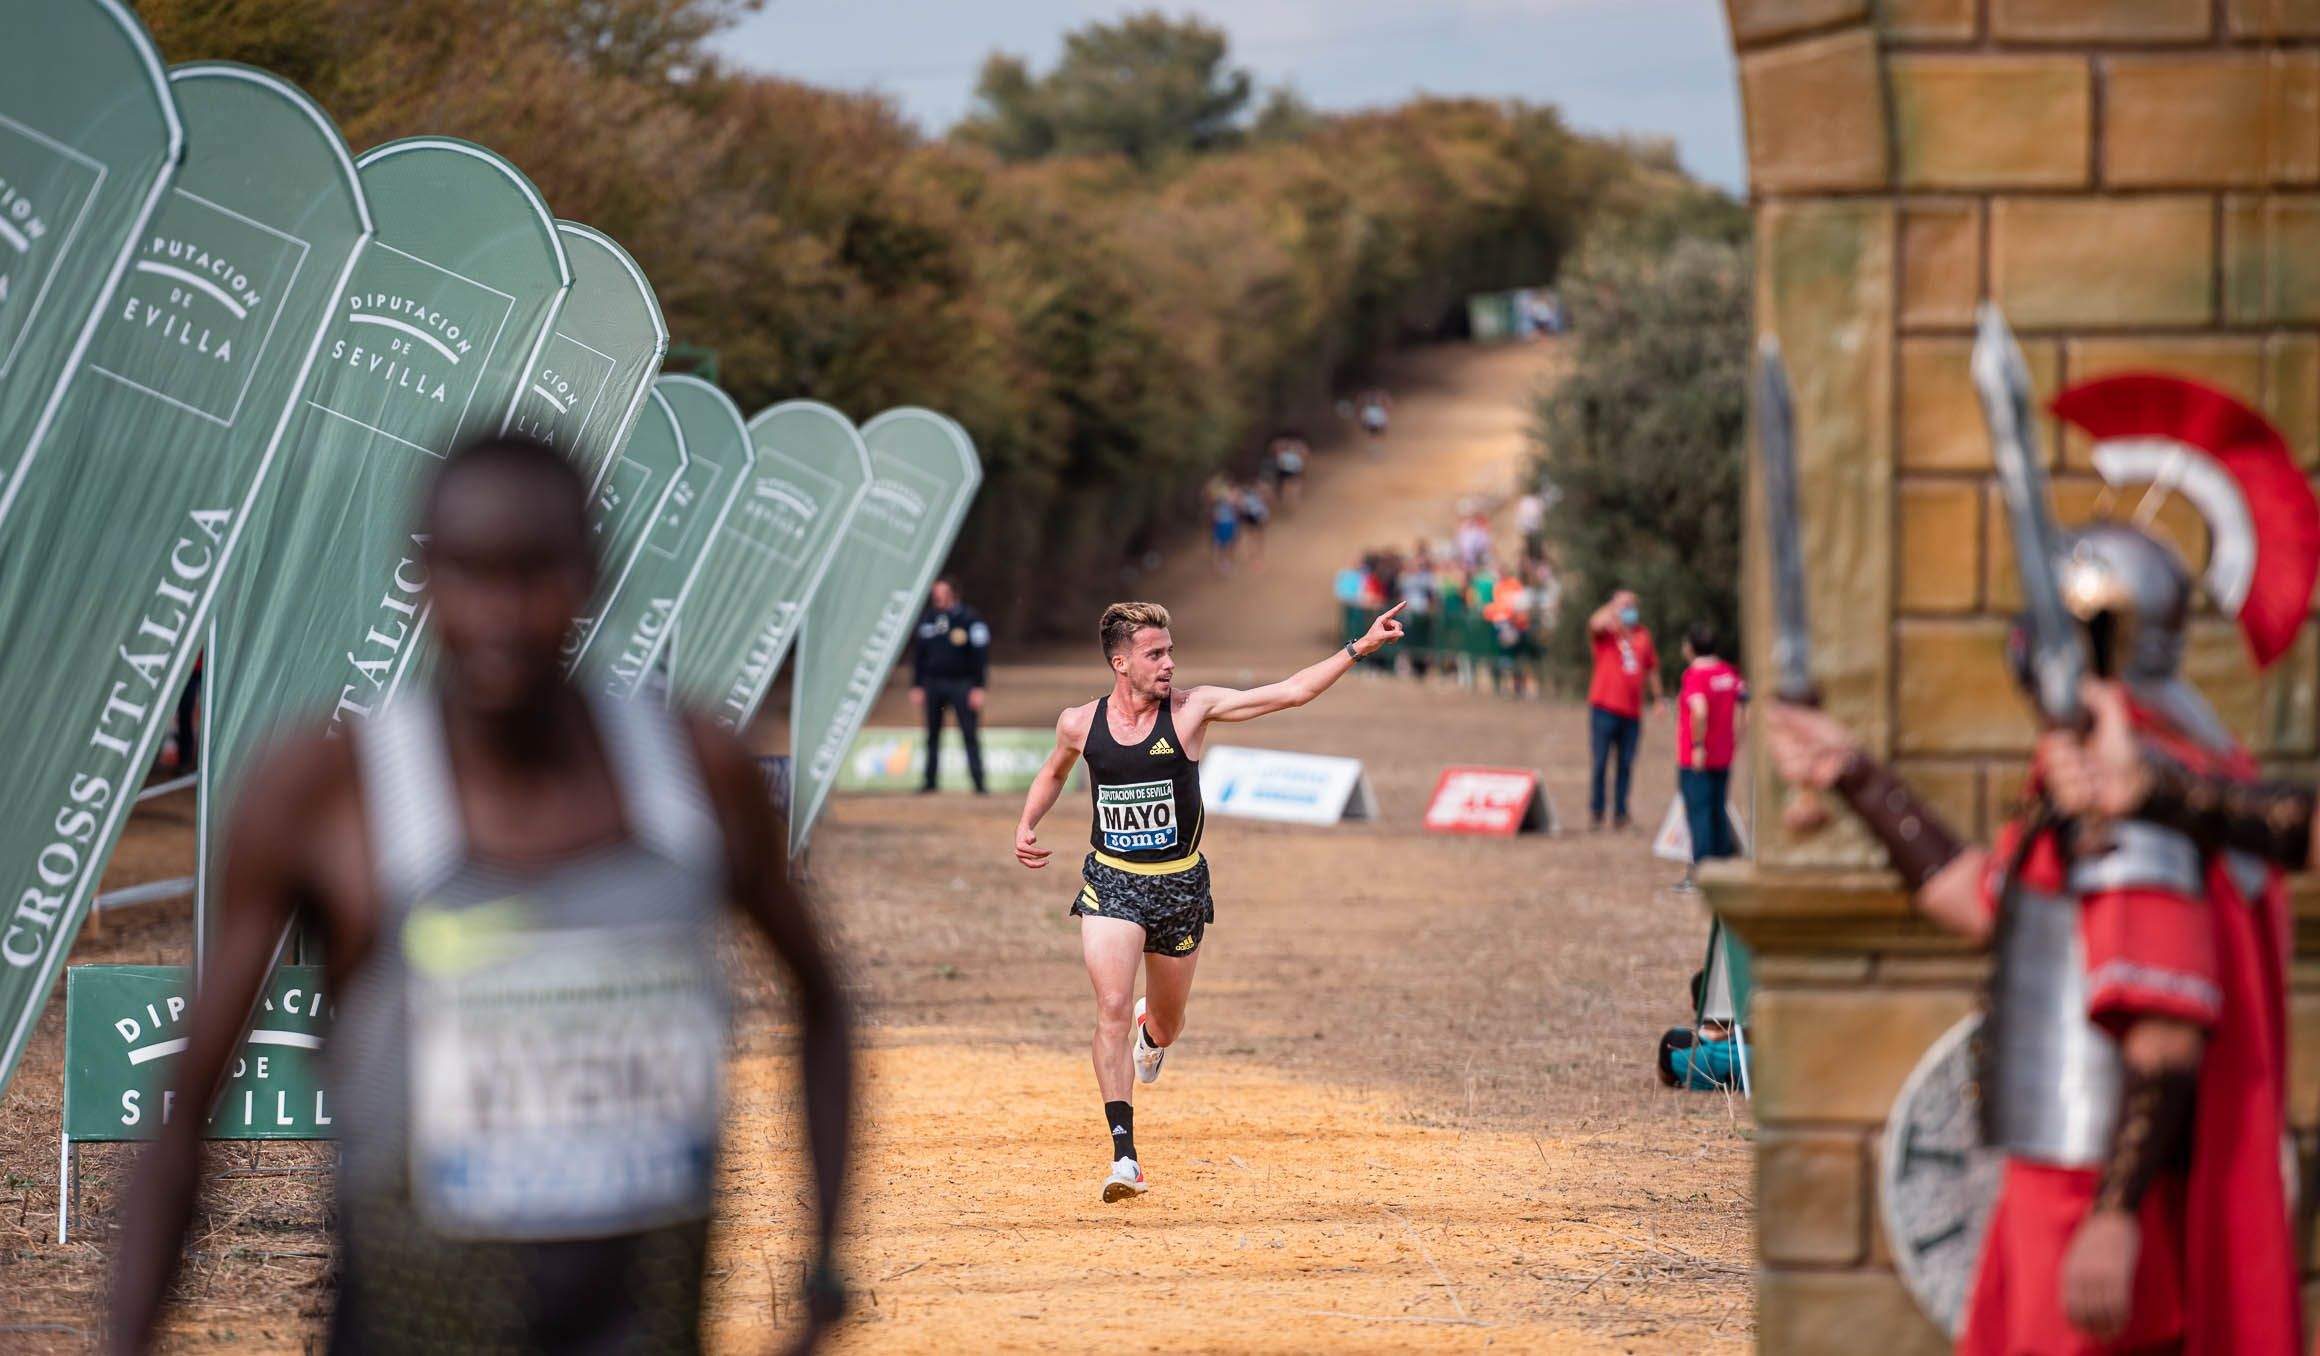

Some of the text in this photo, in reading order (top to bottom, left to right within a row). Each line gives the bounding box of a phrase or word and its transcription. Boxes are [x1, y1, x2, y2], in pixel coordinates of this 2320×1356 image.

[144, 237, 261, 308] PUTACION
[170, 287, 193, 309] DE
[350, 293, 472, 355] DIPUTACION
[391, 338, 412, 356] DE
[332, 340, 446, 403] SEVILLA
[2, 507, 234, 968] CROSS ITÁLICA
[1149, 747, 1175, 756] adidas
[1100, 785, 1172, 801] DIPUTACION DE SEVILLA
[1103, 803, 1171, 831] MAYO
